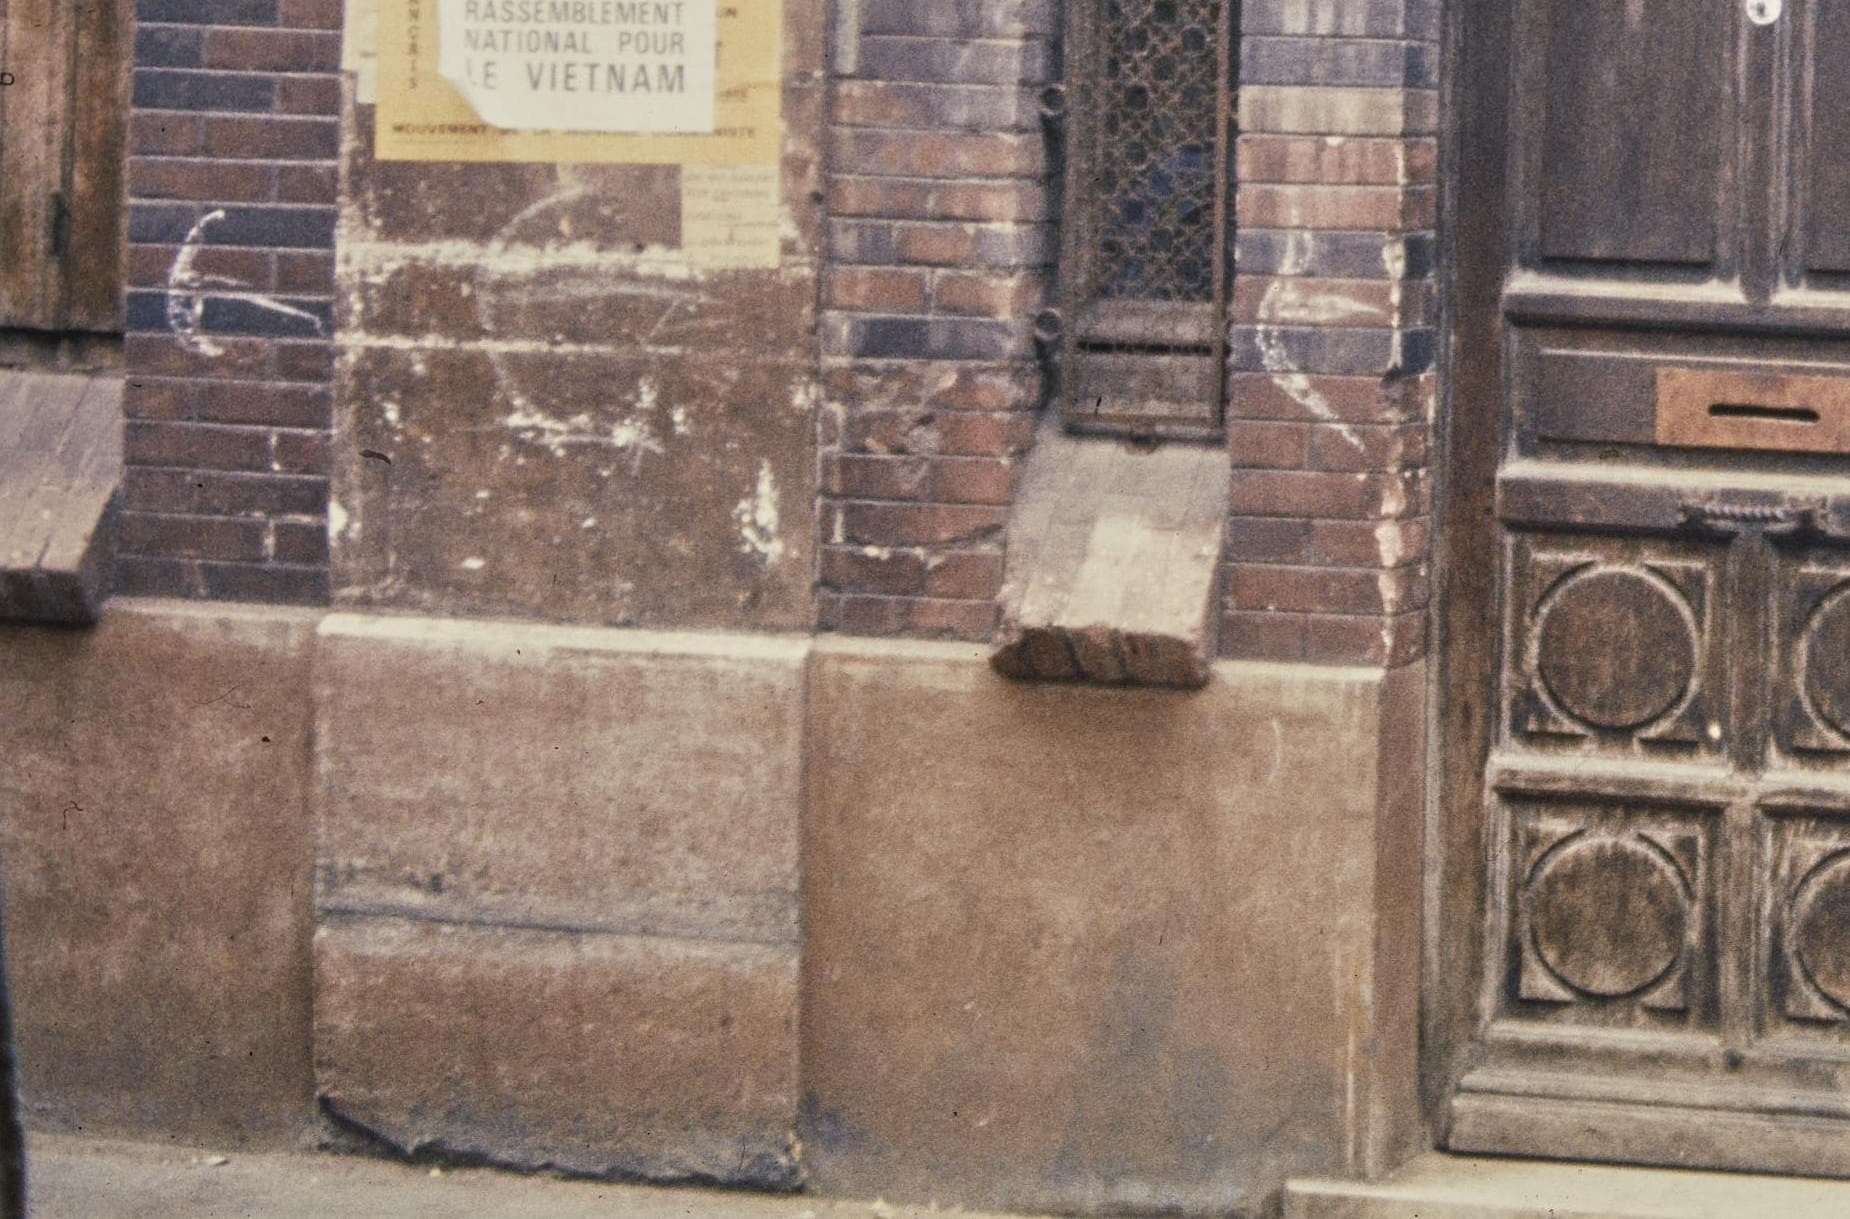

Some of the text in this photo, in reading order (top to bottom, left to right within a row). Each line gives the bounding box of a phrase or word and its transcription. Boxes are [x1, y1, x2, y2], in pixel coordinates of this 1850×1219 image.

[463, 28, 685, 55] NATIONAL POUR
[526, 62, 686, 94] VIETNAM
